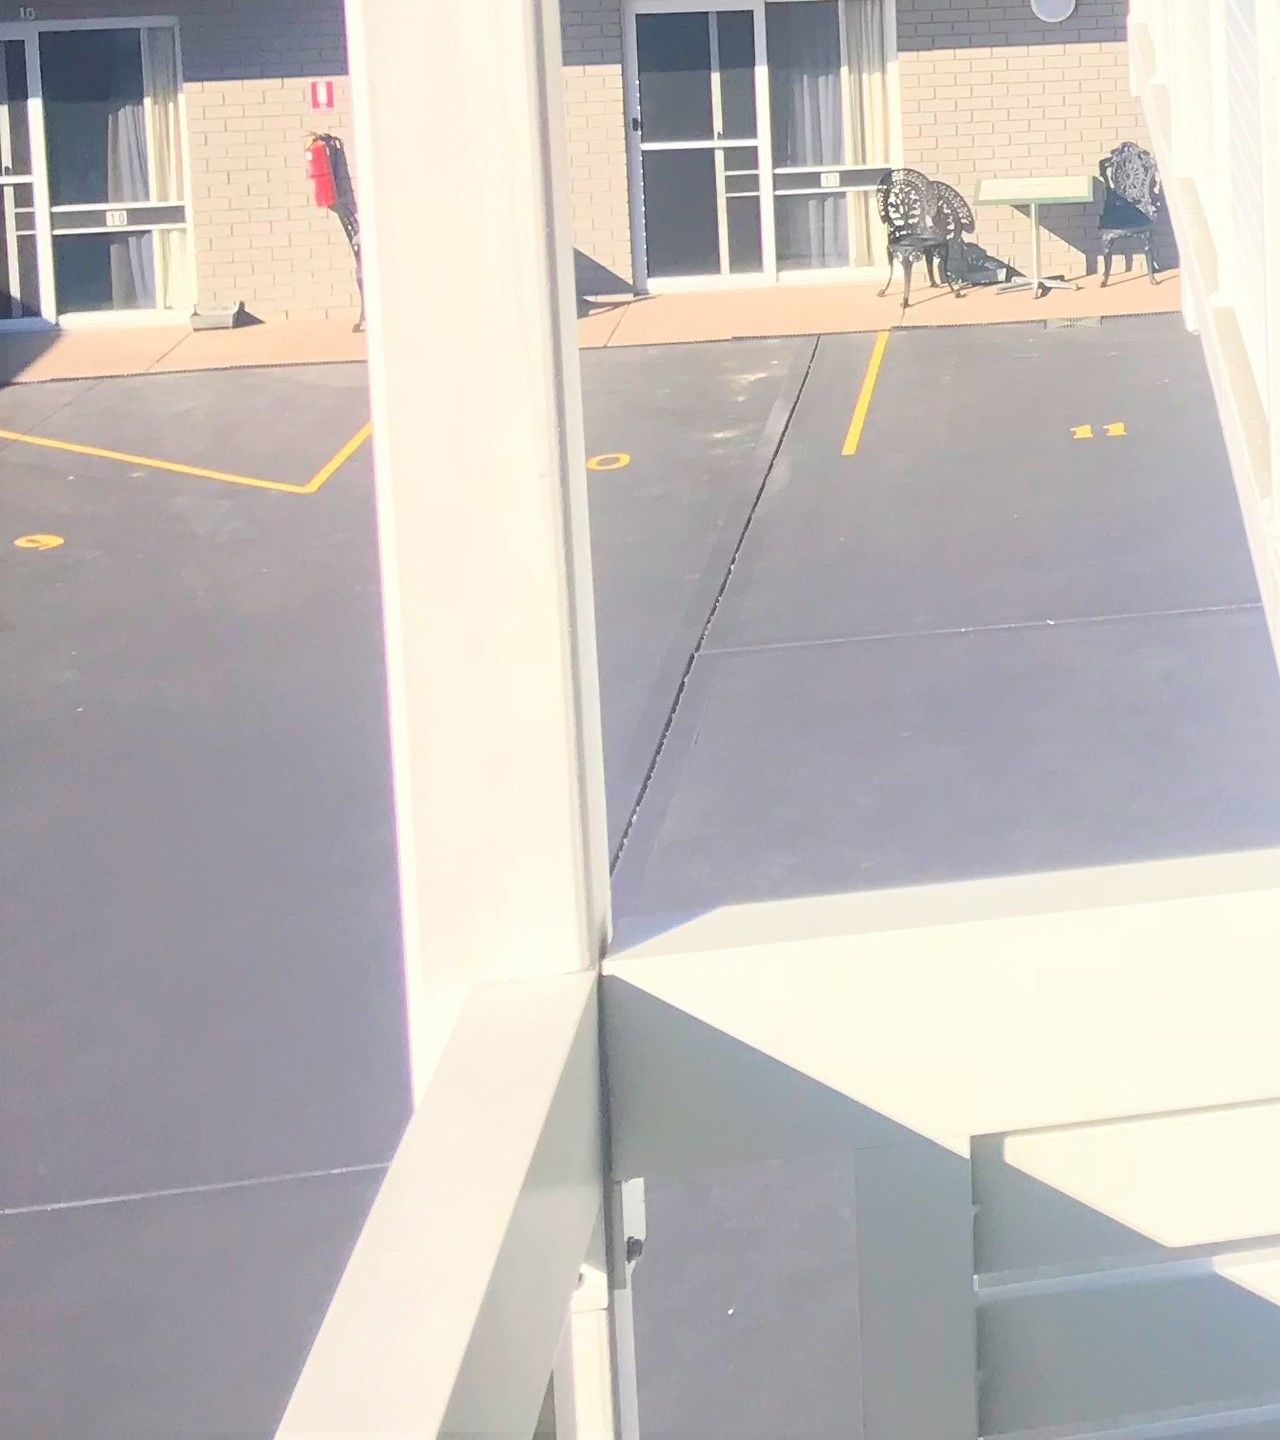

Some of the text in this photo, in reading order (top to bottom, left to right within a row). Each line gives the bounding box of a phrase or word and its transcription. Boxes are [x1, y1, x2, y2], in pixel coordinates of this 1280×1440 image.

[19, 6, 36, 20] 10
[110, 212, 125, 225] 10
[1070, 422, 1127, 439] 11
[13, 534, 65, 551] 9
